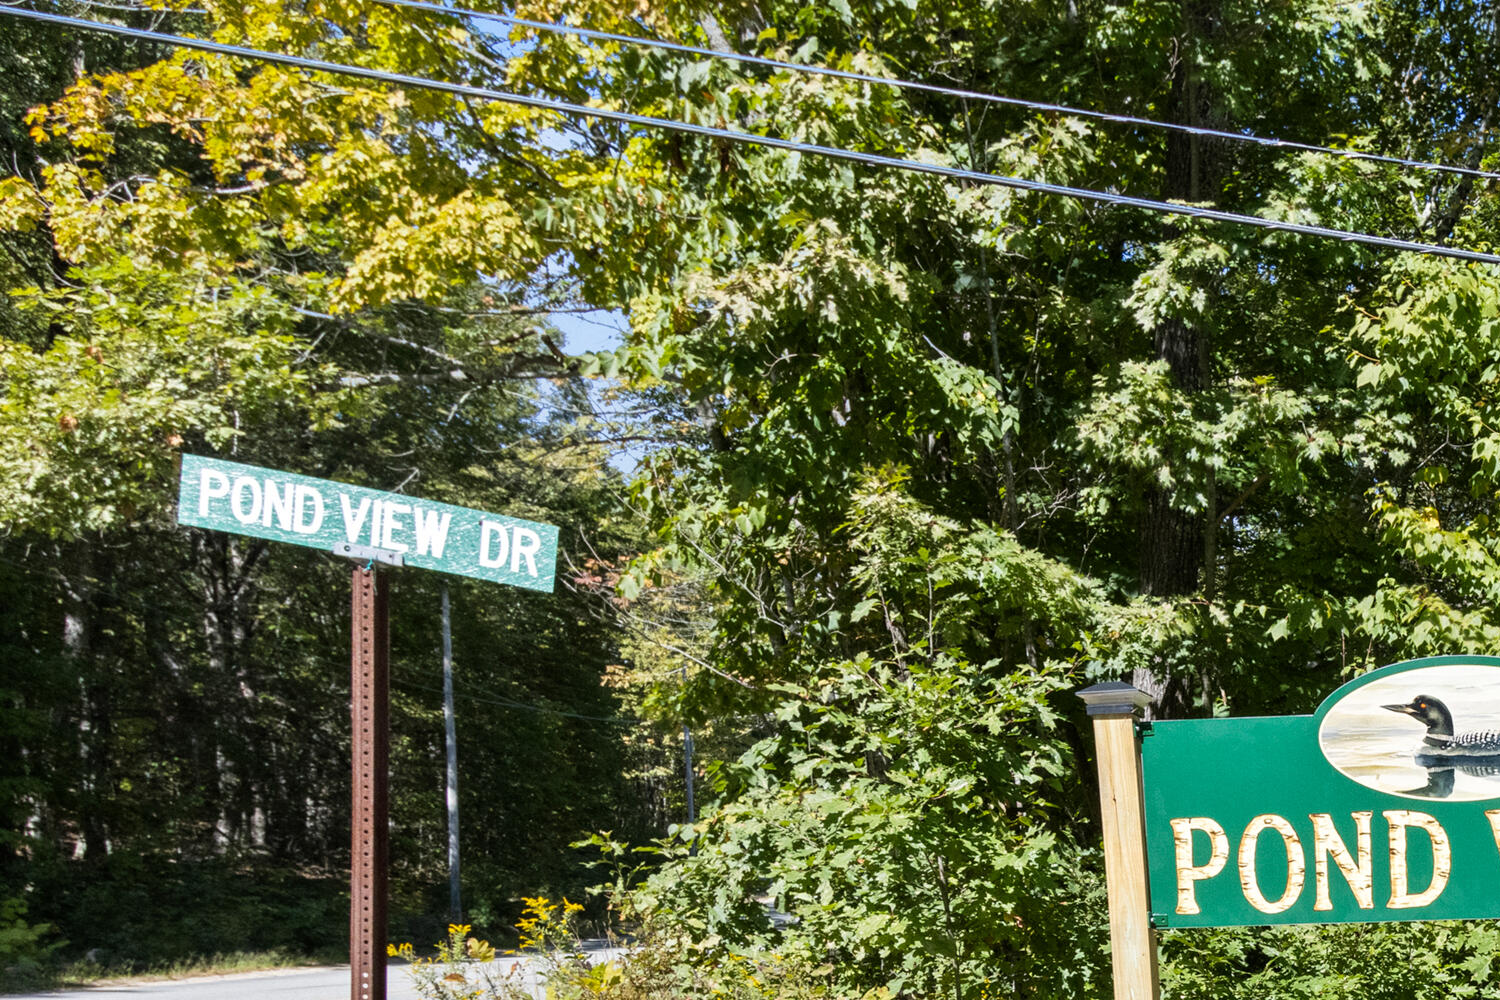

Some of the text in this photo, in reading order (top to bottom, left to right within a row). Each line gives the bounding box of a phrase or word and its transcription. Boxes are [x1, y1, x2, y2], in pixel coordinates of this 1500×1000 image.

[200, 468, 541, 577] POND VIEW DR
[1170, 810, 1451, 914] POND
